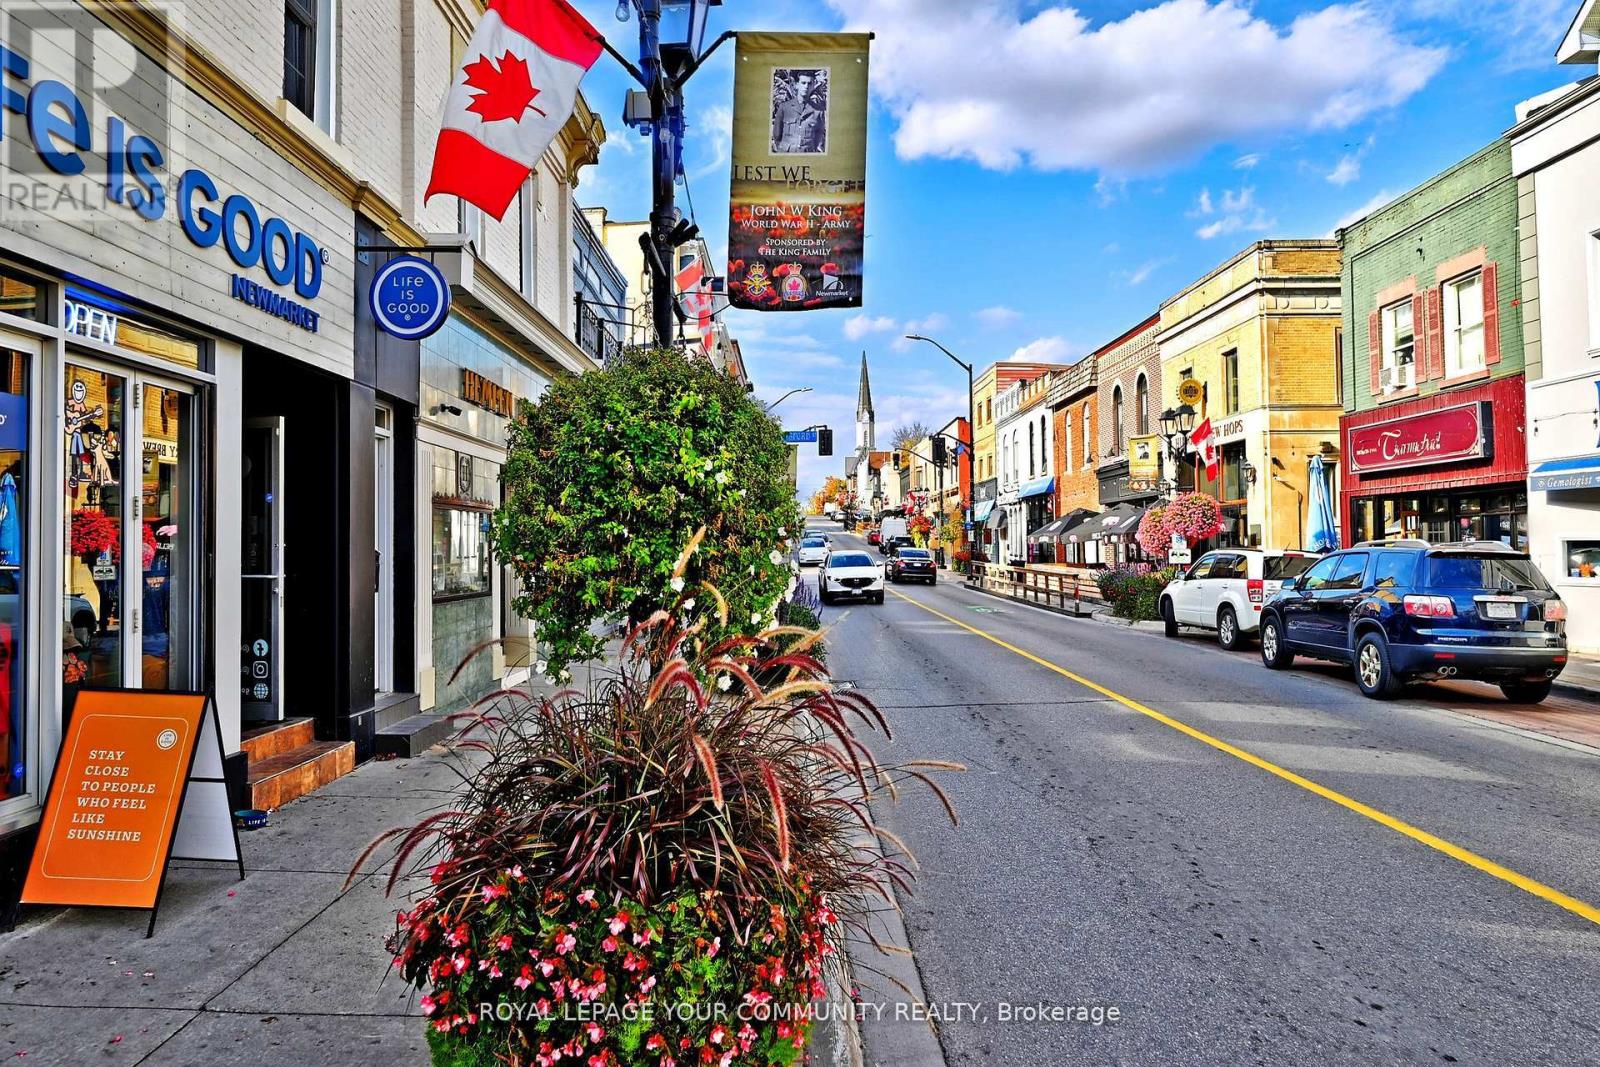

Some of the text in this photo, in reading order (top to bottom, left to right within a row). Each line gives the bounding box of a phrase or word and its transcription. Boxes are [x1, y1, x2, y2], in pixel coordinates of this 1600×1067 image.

[734, 165, 811, 181] LEST WE
[750, 204, 843, 217] JOHN W KING
[741, 219, 779, 229] WORLD
[781, 220, 803, 229] WAR
[821, 220, 851, 229] ARMY
[177, 169, 323, 299] GOOD
[765, 237, 827, 246] SPONSORED BY
[759, 247, 832, 256] THE KING FAMILY
[401, 289, 415, 300] IS
[231, 273, 321, 333] NEWMARKET
[387, 302, 430, 314] GOOD
[1223, 419, 1244, 437] HOPS
[88, 749, 125, 760] STAY
[84, 765, 130, 777] CLOSE
[81, 781, 156, 794] TO PEOPLE
[77, 796, 147, 809] WHO FEEL
[72, 812, 105, 824] LIKE
[67, 828, 142, 842] SUNSHINE
